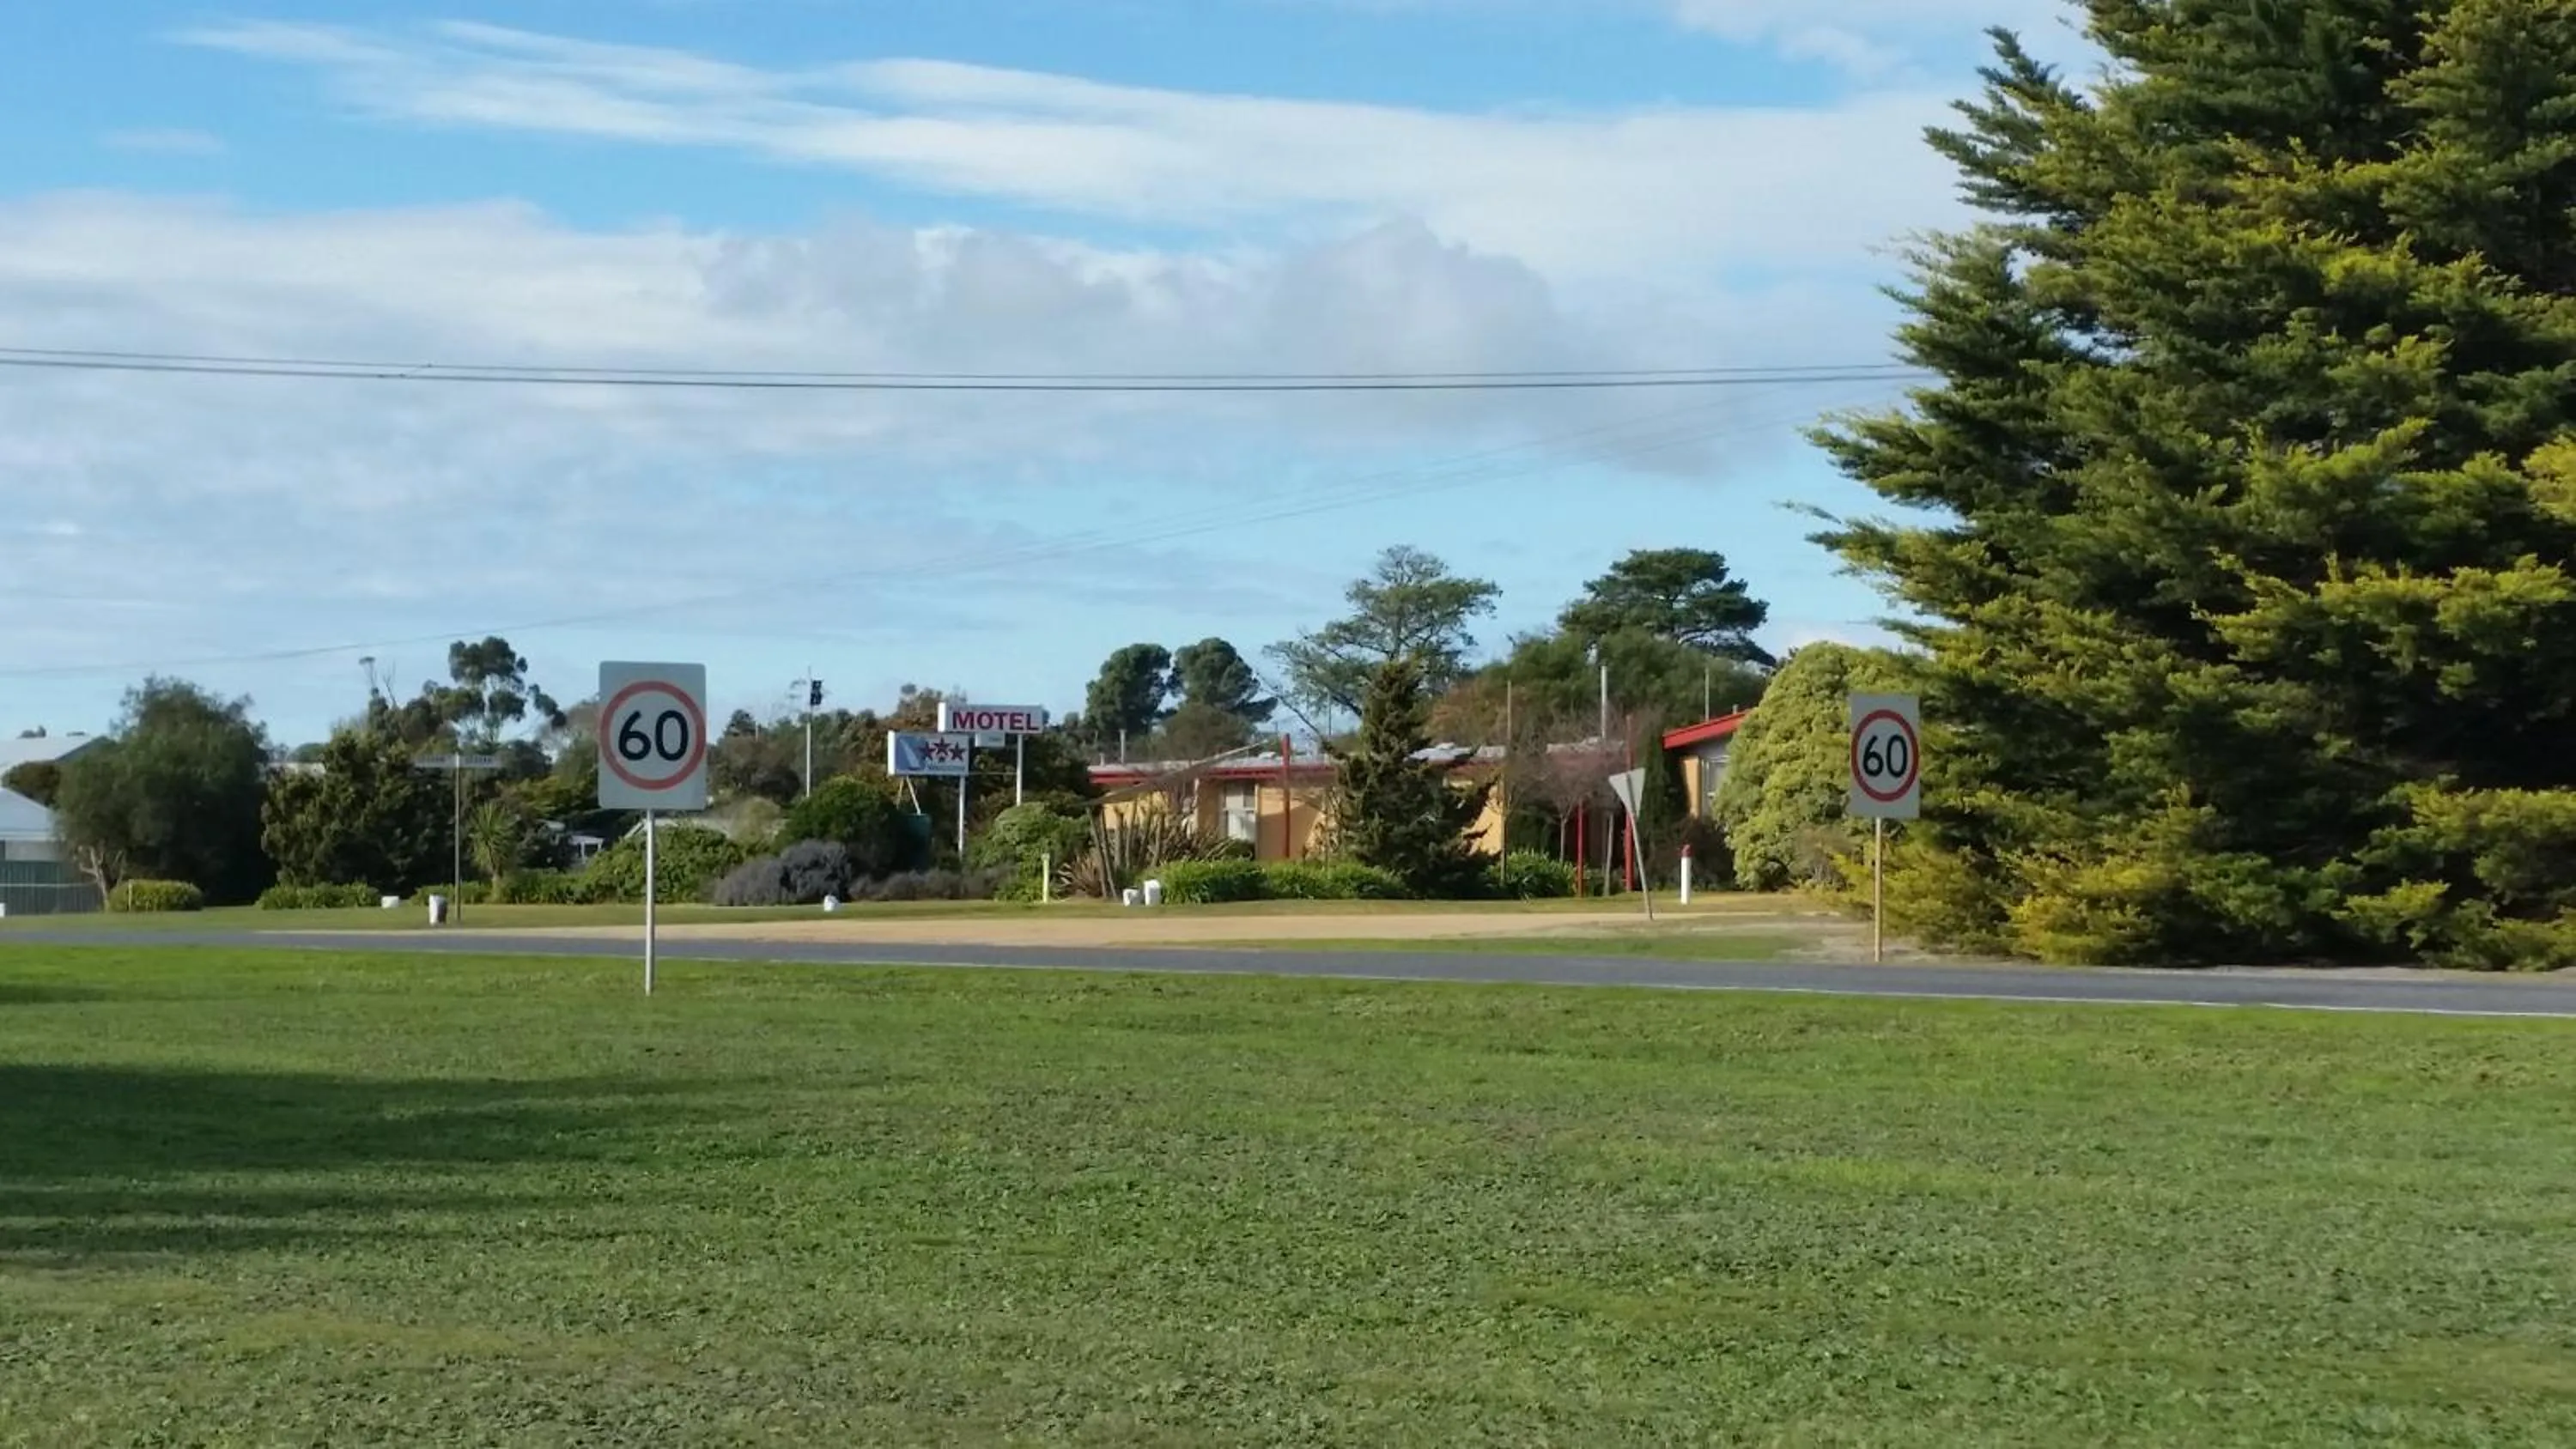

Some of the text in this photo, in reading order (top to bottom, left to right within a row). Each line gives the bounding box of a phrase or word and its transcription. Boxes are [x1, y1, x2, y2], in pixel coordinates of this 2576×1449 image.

[618, 710, 689, 761] 60
[952, 712, 1039, 730] MOTEL
[1862, 734, 1908, 778] 60
